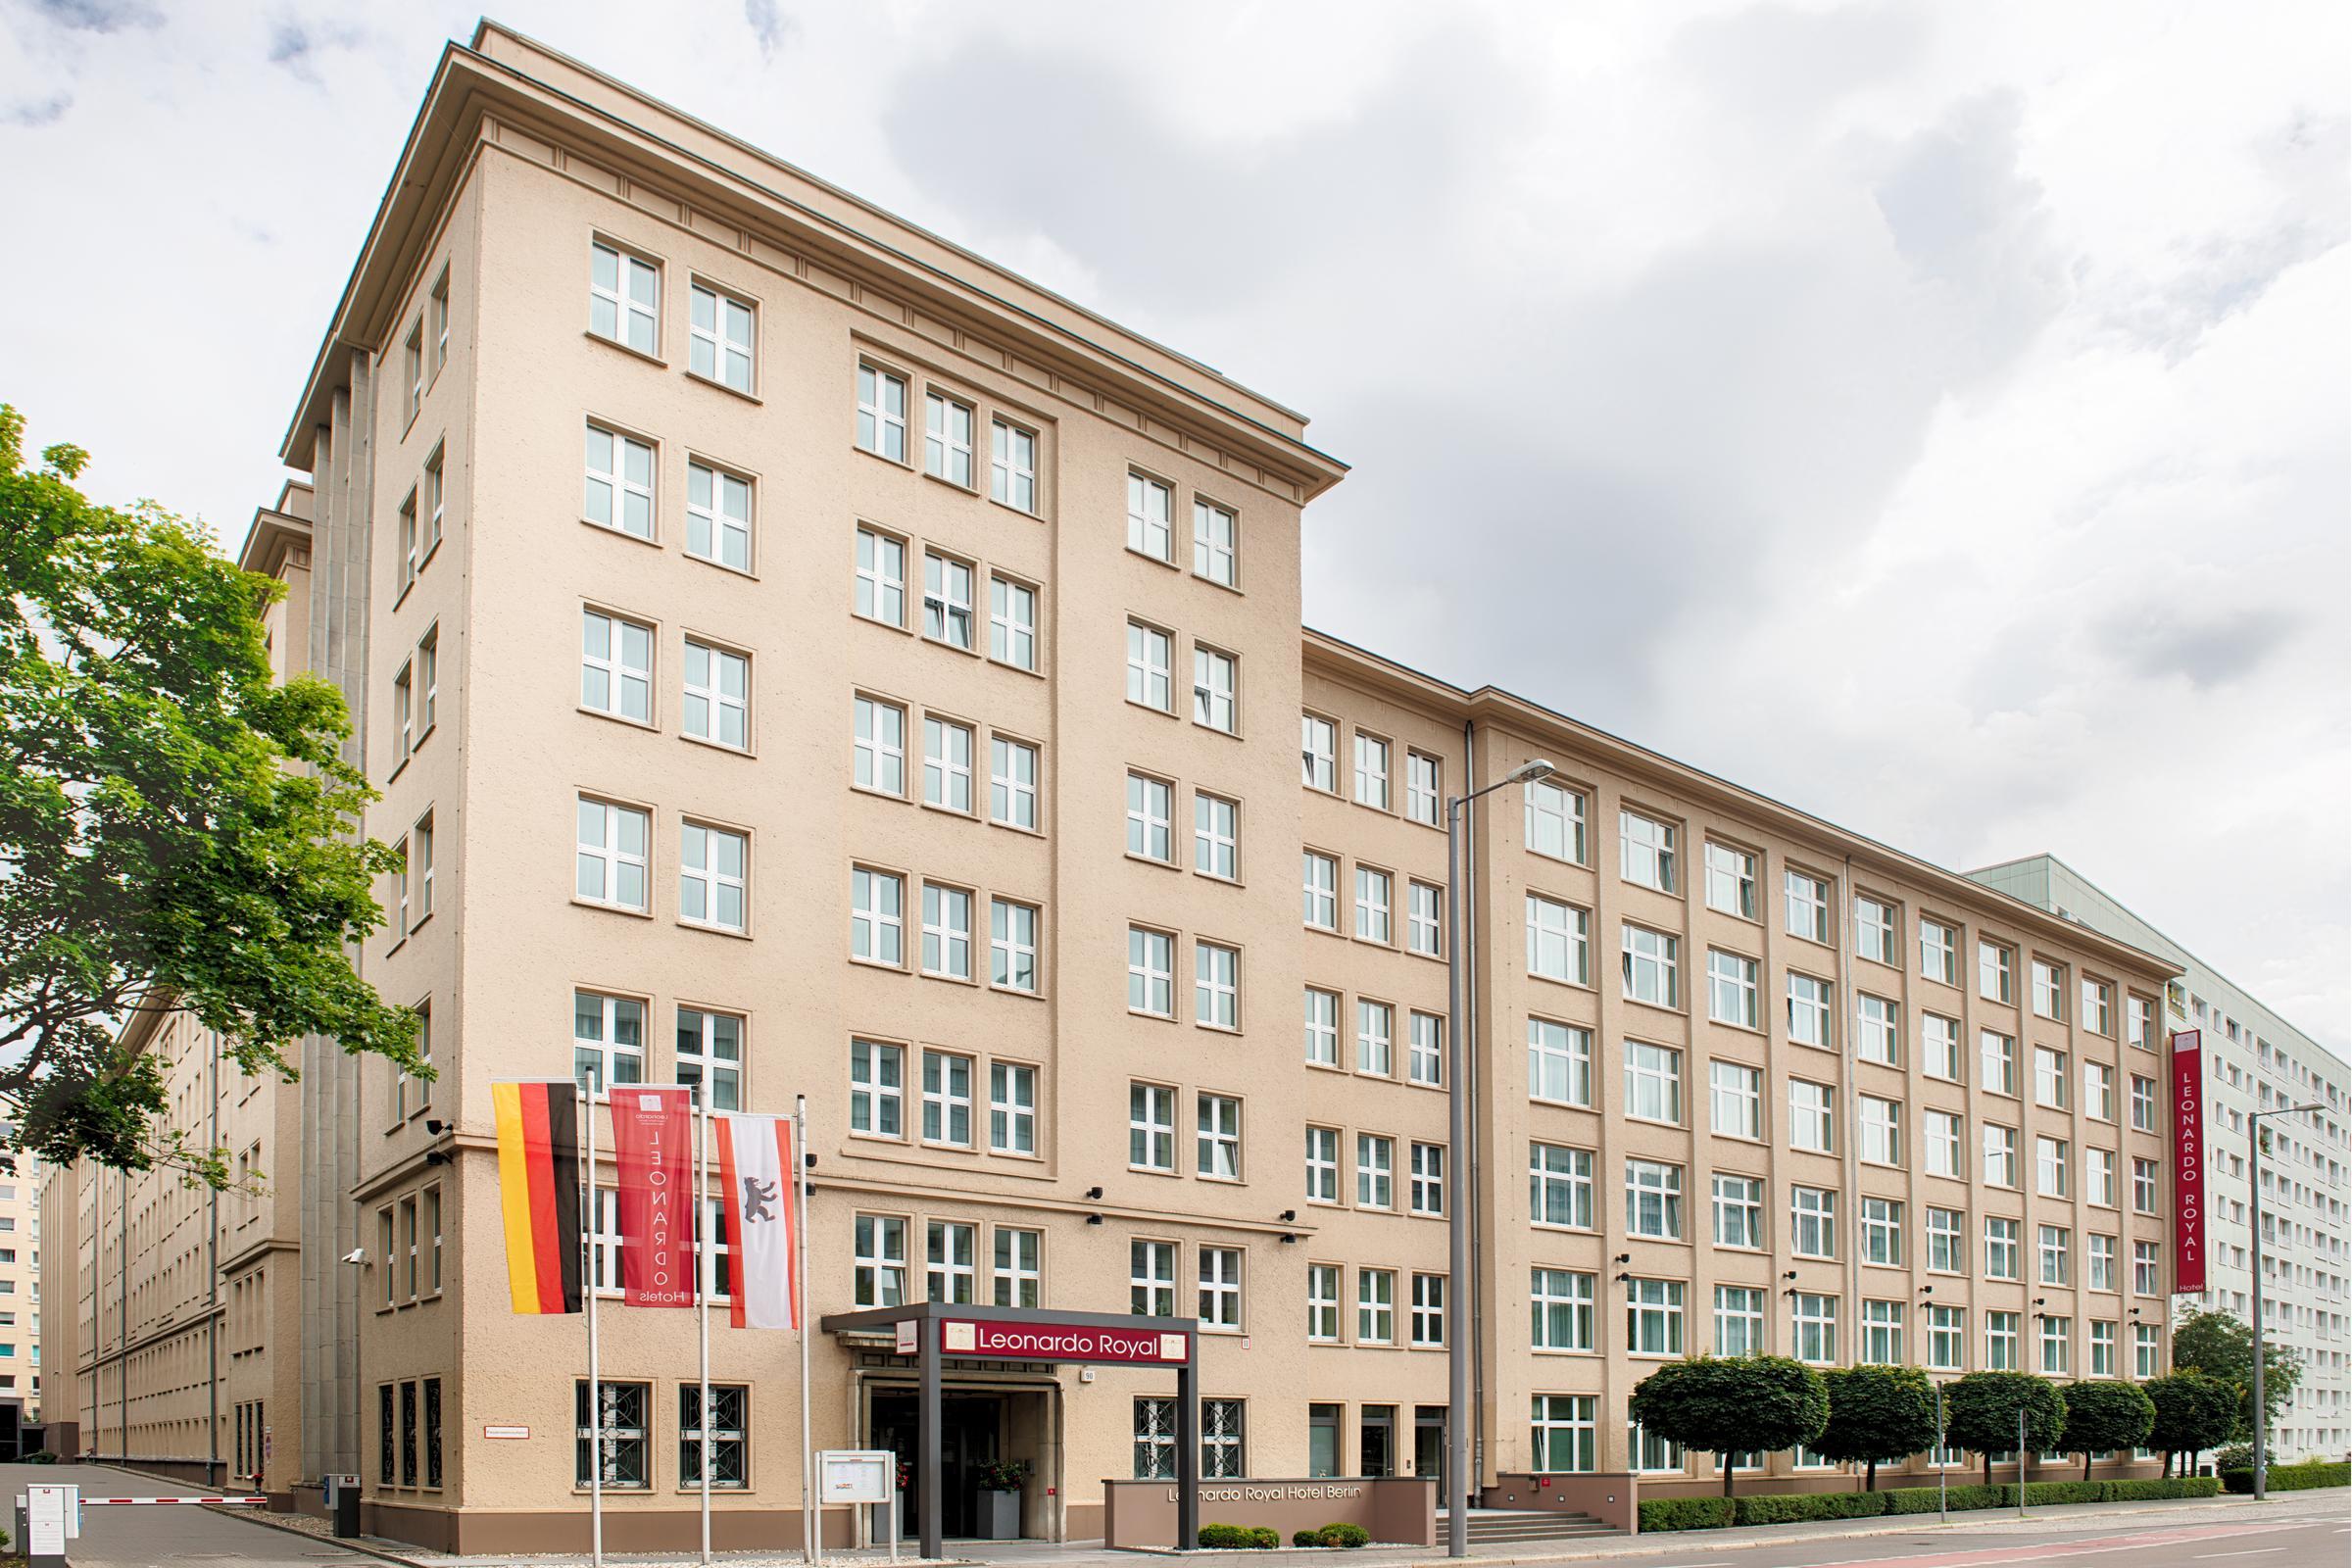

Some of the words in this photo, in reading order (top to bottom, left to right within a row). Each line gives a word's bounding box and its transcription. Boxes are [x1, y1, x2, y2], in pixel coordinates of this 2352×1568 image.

[2180, 1073, 2197, 1182] LEONARDO
[2183, 1195, 2197, 1261] ROYAL
[2179, 1283, 2203, 1292] Hotel
[979, 1328, 1093, 1353] Leonardo
[1099, 1334, 1157, 1359] Royal
[1167, 1488, 1241, 1502] Lnardo
[1245, 1487, 1284, 1503] Royal
[1288, 1485, 1323, 1500] Hotel
[1327, 1484, 1361, 1498] Berlin
